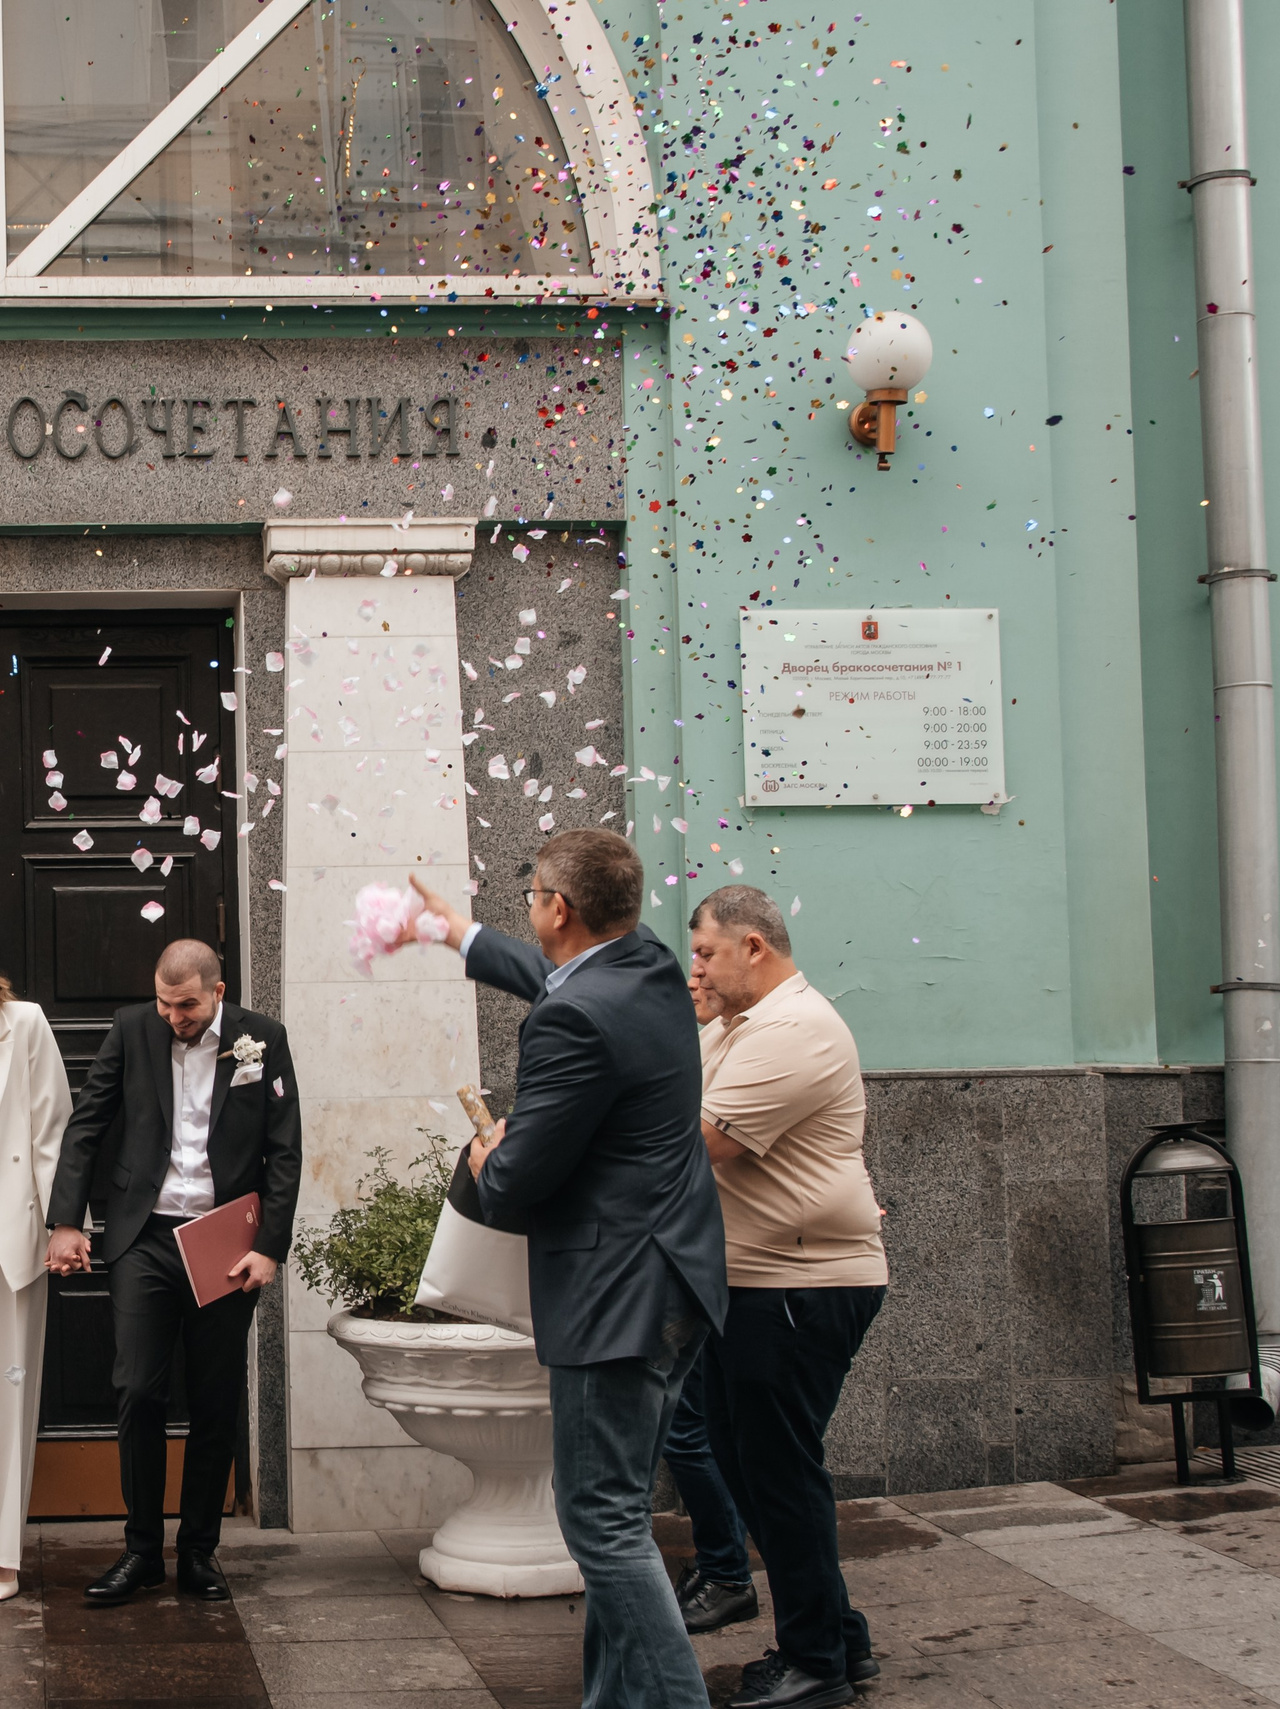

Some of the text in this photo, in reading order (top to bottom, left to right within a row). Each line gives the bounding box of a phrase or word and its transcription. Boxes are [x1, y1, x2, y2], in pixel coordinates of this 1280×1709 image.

[781, 661, 962, 675] Дворец бракосочетания № 1
[829, 690, 916, 701] РЕЖИМ РАБОТЫ
[922, 706, 947, 717] 9:00
[958, 706, 986, 716] 18:00
[923, 723, 947, 733] 9:00
[956, 722, 987, 733] 20:00
[924, 740, 948, 750] 9:00
[957, 739, 987, 750] 23:59
[917, 757, 949, 767] 00:00
[959, 756, 988, 767] 19:00
[442, 1301, 470, 1315] Calvin
[470, 1309, 493, 1322] Klein
